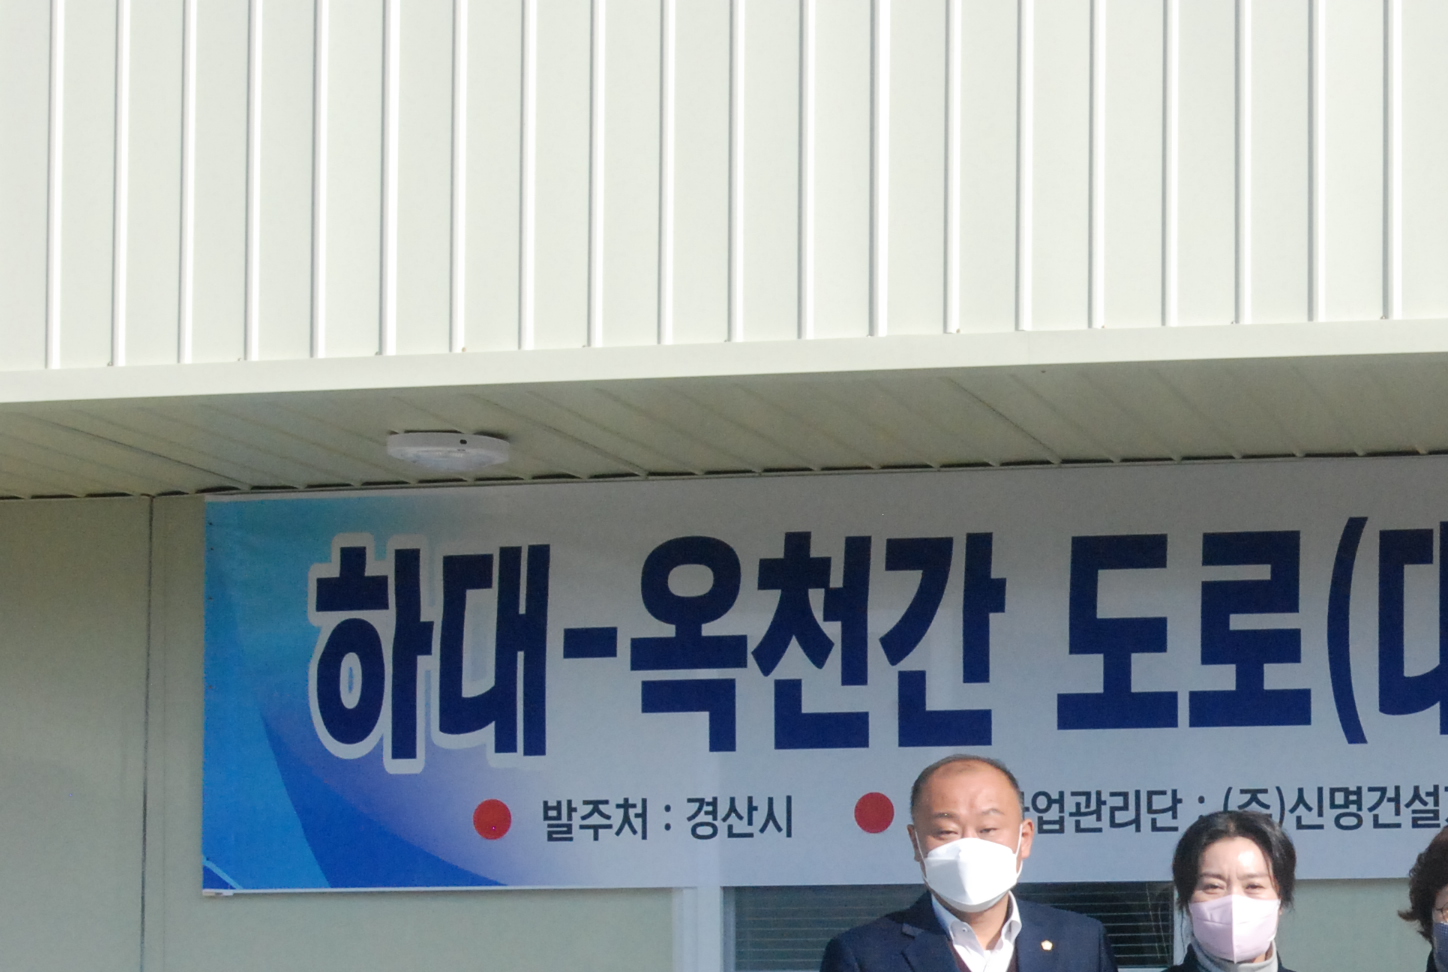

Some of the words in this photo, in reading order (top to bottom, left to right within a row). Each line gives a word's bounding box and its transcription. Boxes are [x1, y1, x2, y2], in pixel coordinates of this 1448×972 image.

[315, 531, 1007, 760] 하대-옥천간
[542, 797, 648, 842] 발주처
[686, 795, 793, 840] 경산시
[1021, 789, 1183, 834] 업관리단
